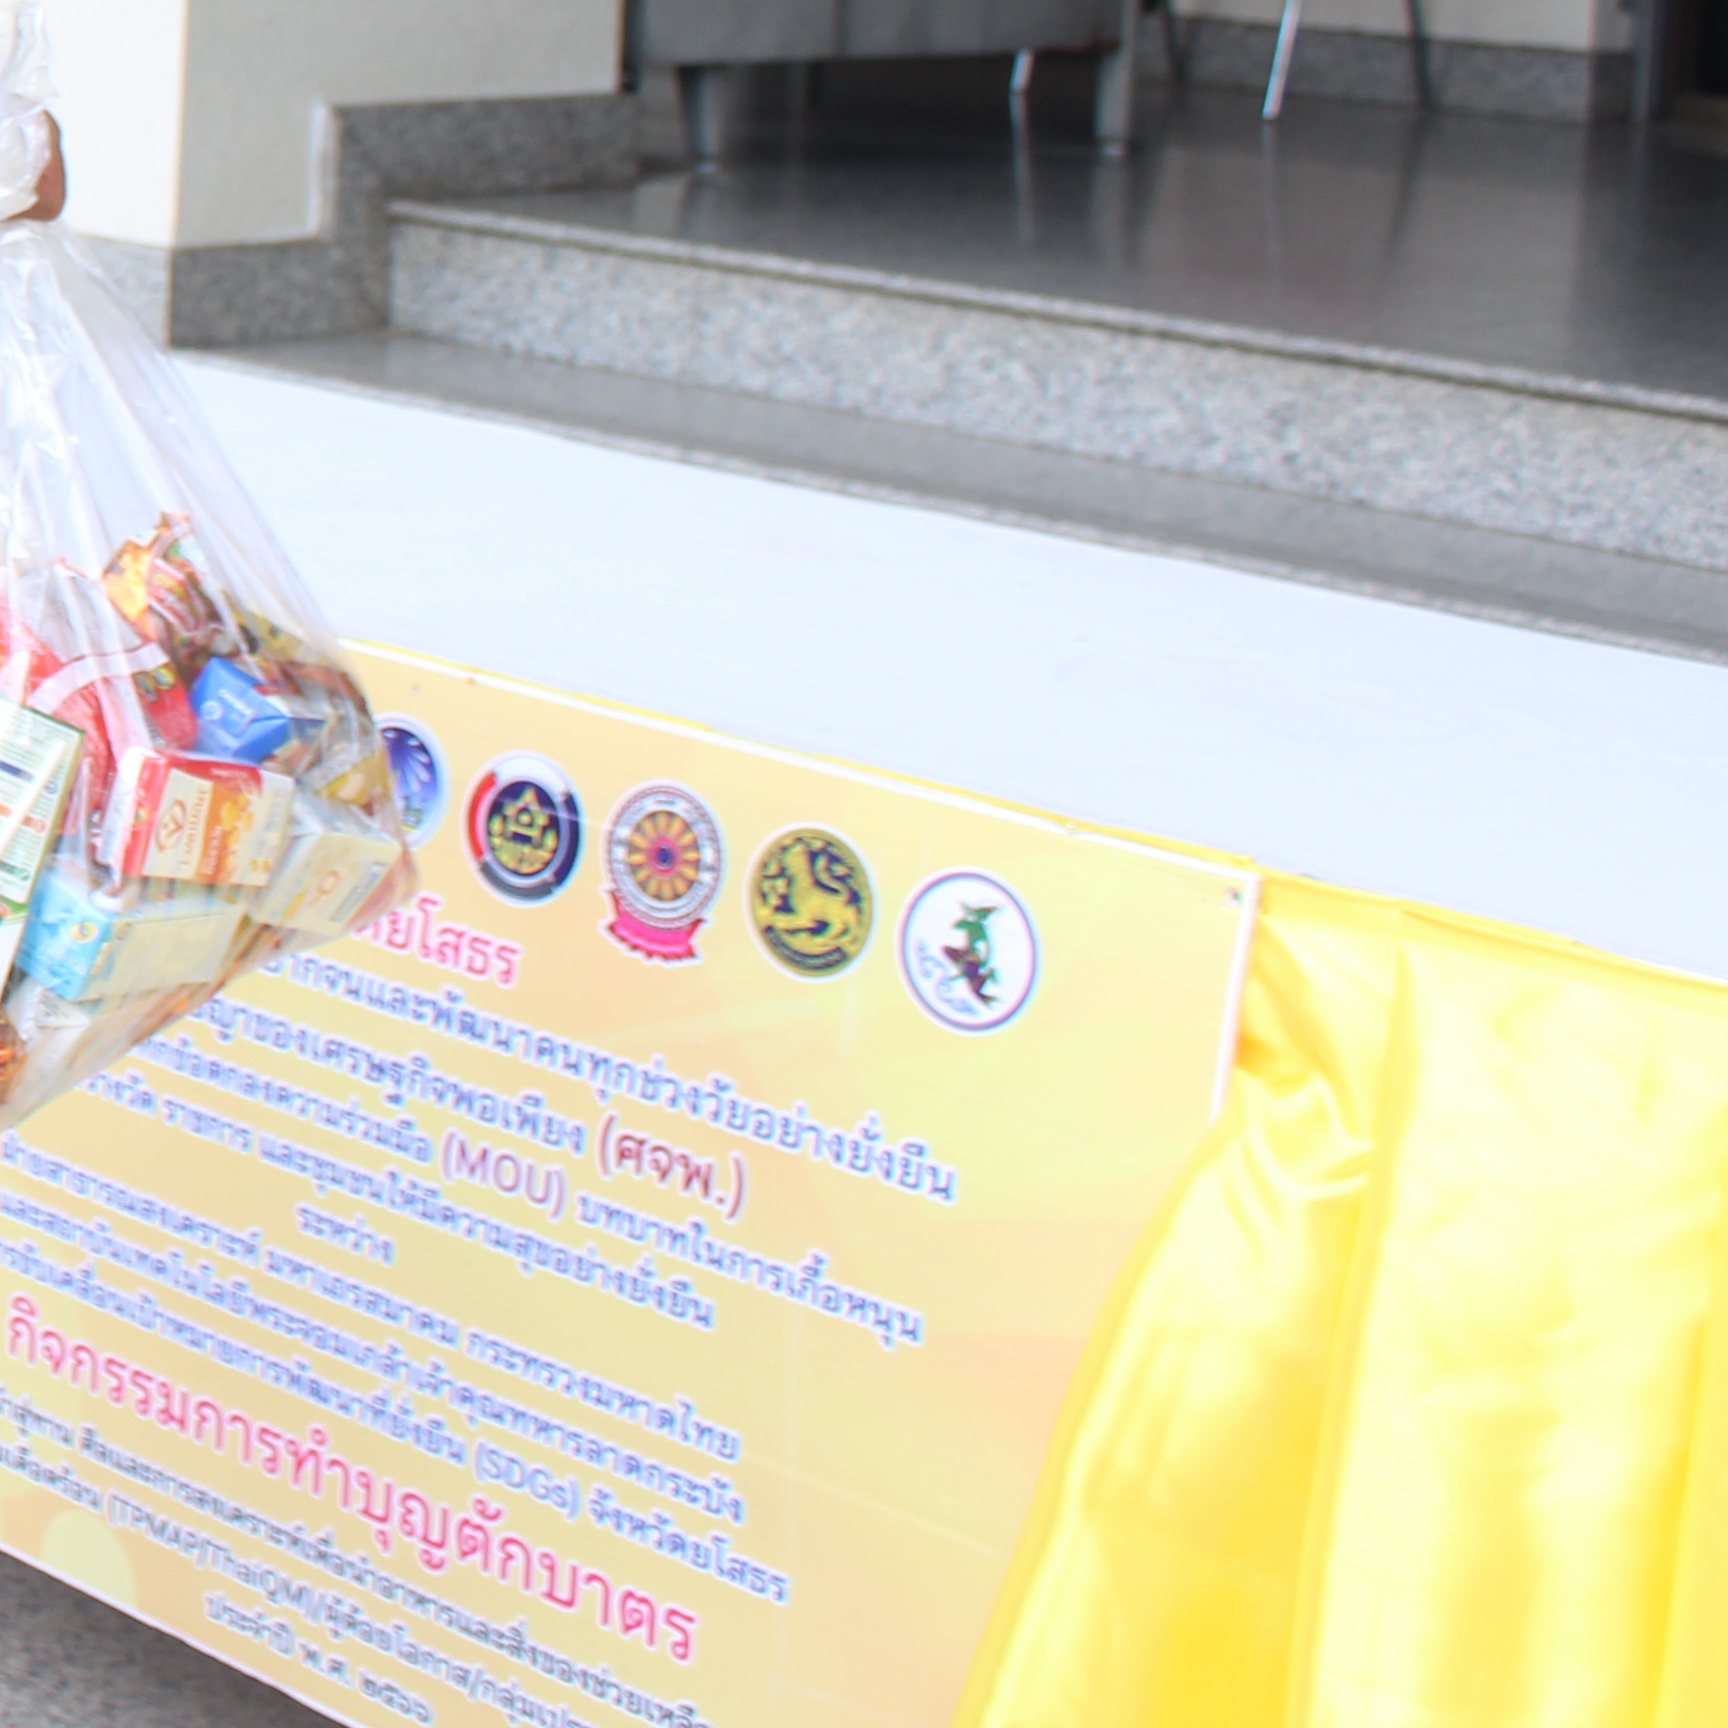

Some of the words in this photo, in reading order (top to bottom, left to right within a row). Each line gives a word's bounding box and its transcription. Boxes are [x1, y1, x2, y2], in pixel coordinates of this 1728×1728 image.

[192, 998, 583, 1152] ญาของเศรษฐกิจพอเพียง
[598, 1115, 742, 1218] (ศจพ.)
[297, 1205, 391, 1261] ระหว่าง
[444, 1131, 564, 1218] (MOU)
[578, 1196, 921, 1347] บทบาทในการเกื้อหนุน
[9, 1296, 695, 1658] กิจกรรมการทำบุญตักบาตร
[467, 1332, 737, 1458] กระทรวงมหาดไทย
[476, 1441, 578, 1518] (SDGs)
[590, 1487, 787, 1601] จังหวัดยโสธร
